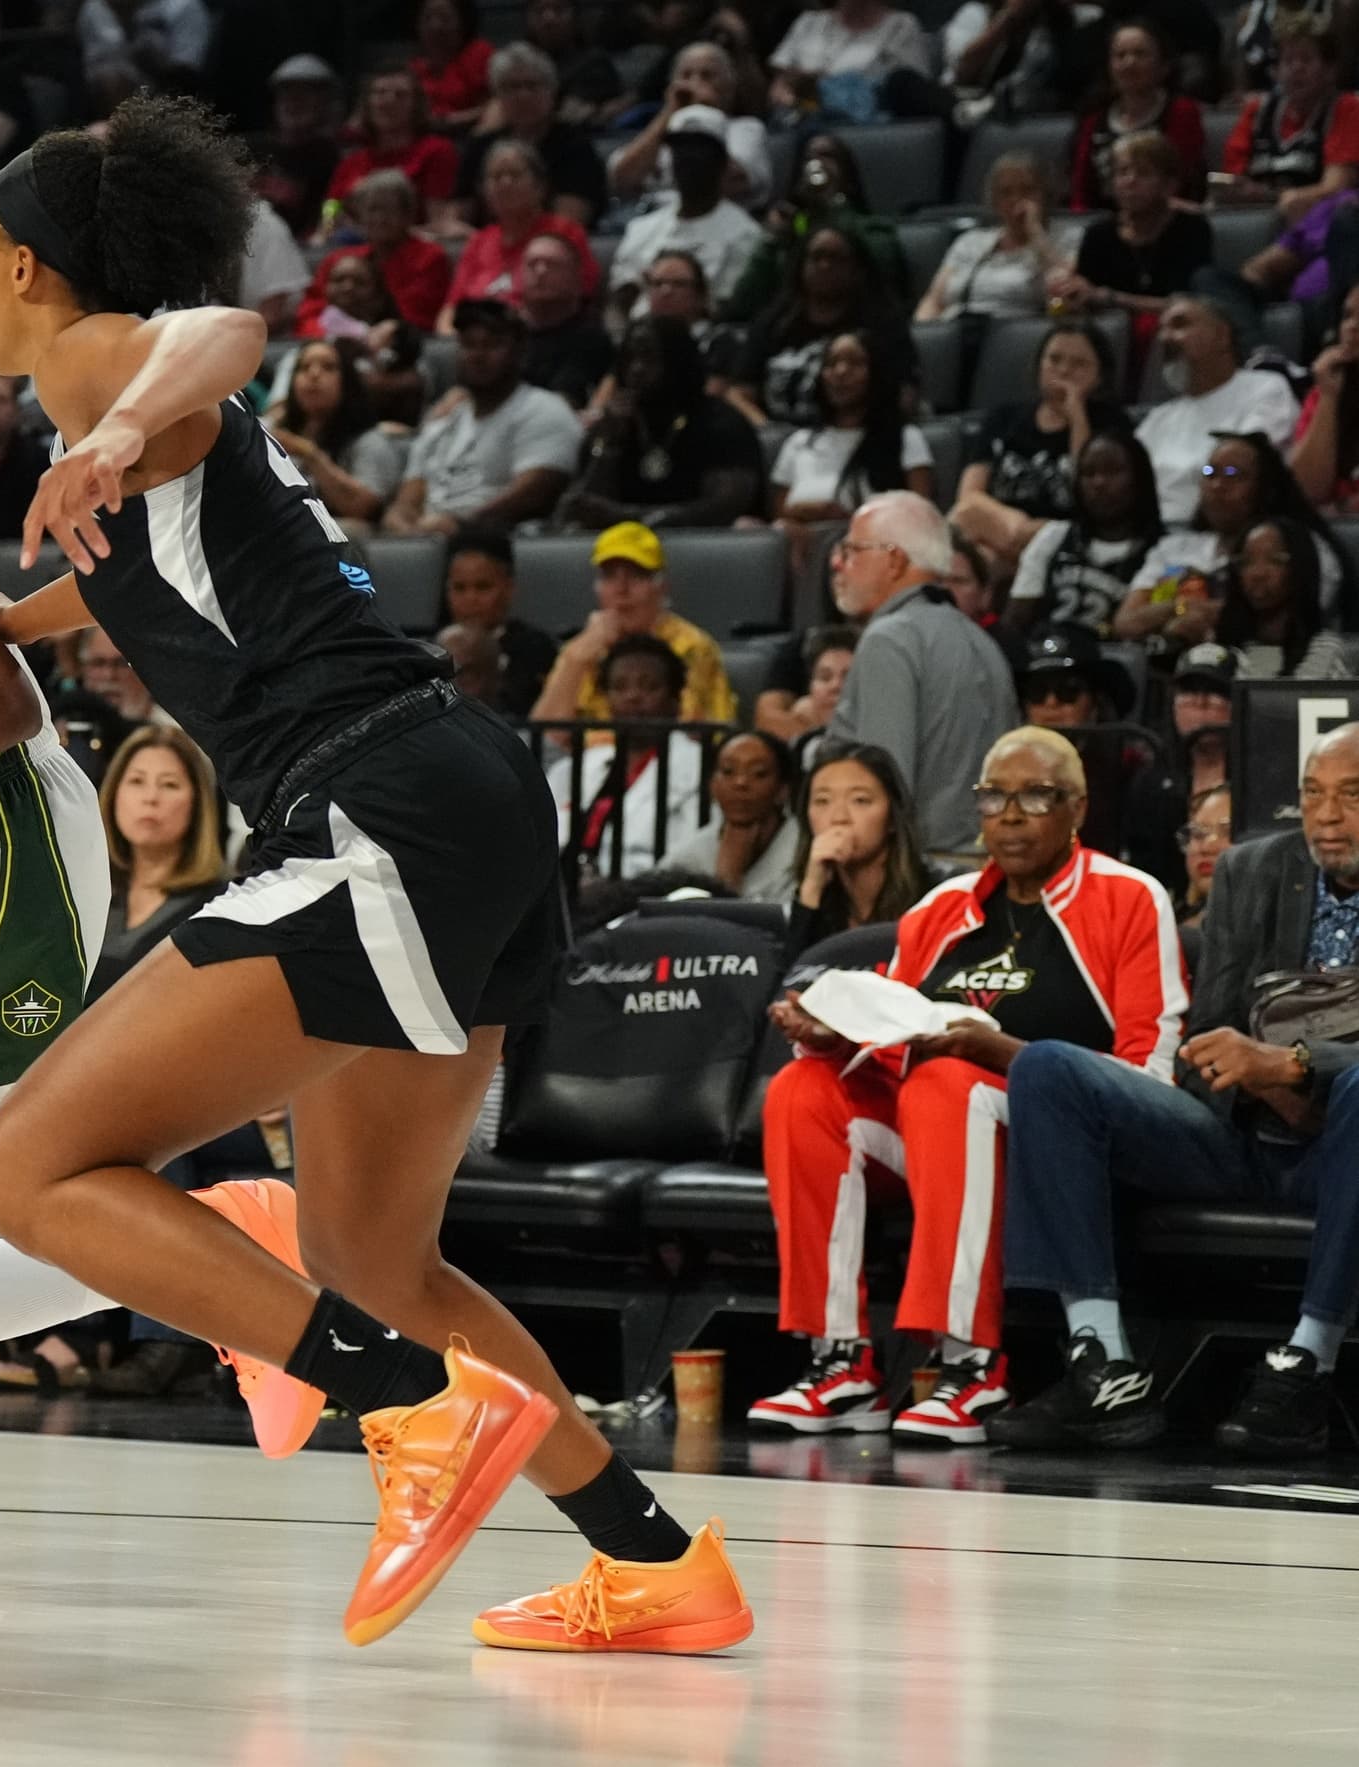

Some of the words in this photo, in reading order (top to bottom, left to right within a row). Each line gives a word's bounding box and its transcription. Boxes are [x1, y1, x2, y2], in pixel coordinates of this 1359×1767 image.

[673, 954, 759, 980] ULTRA
[945, 970, 1028, 991] ACES
[622, 988, 702, 1015] ARENA
